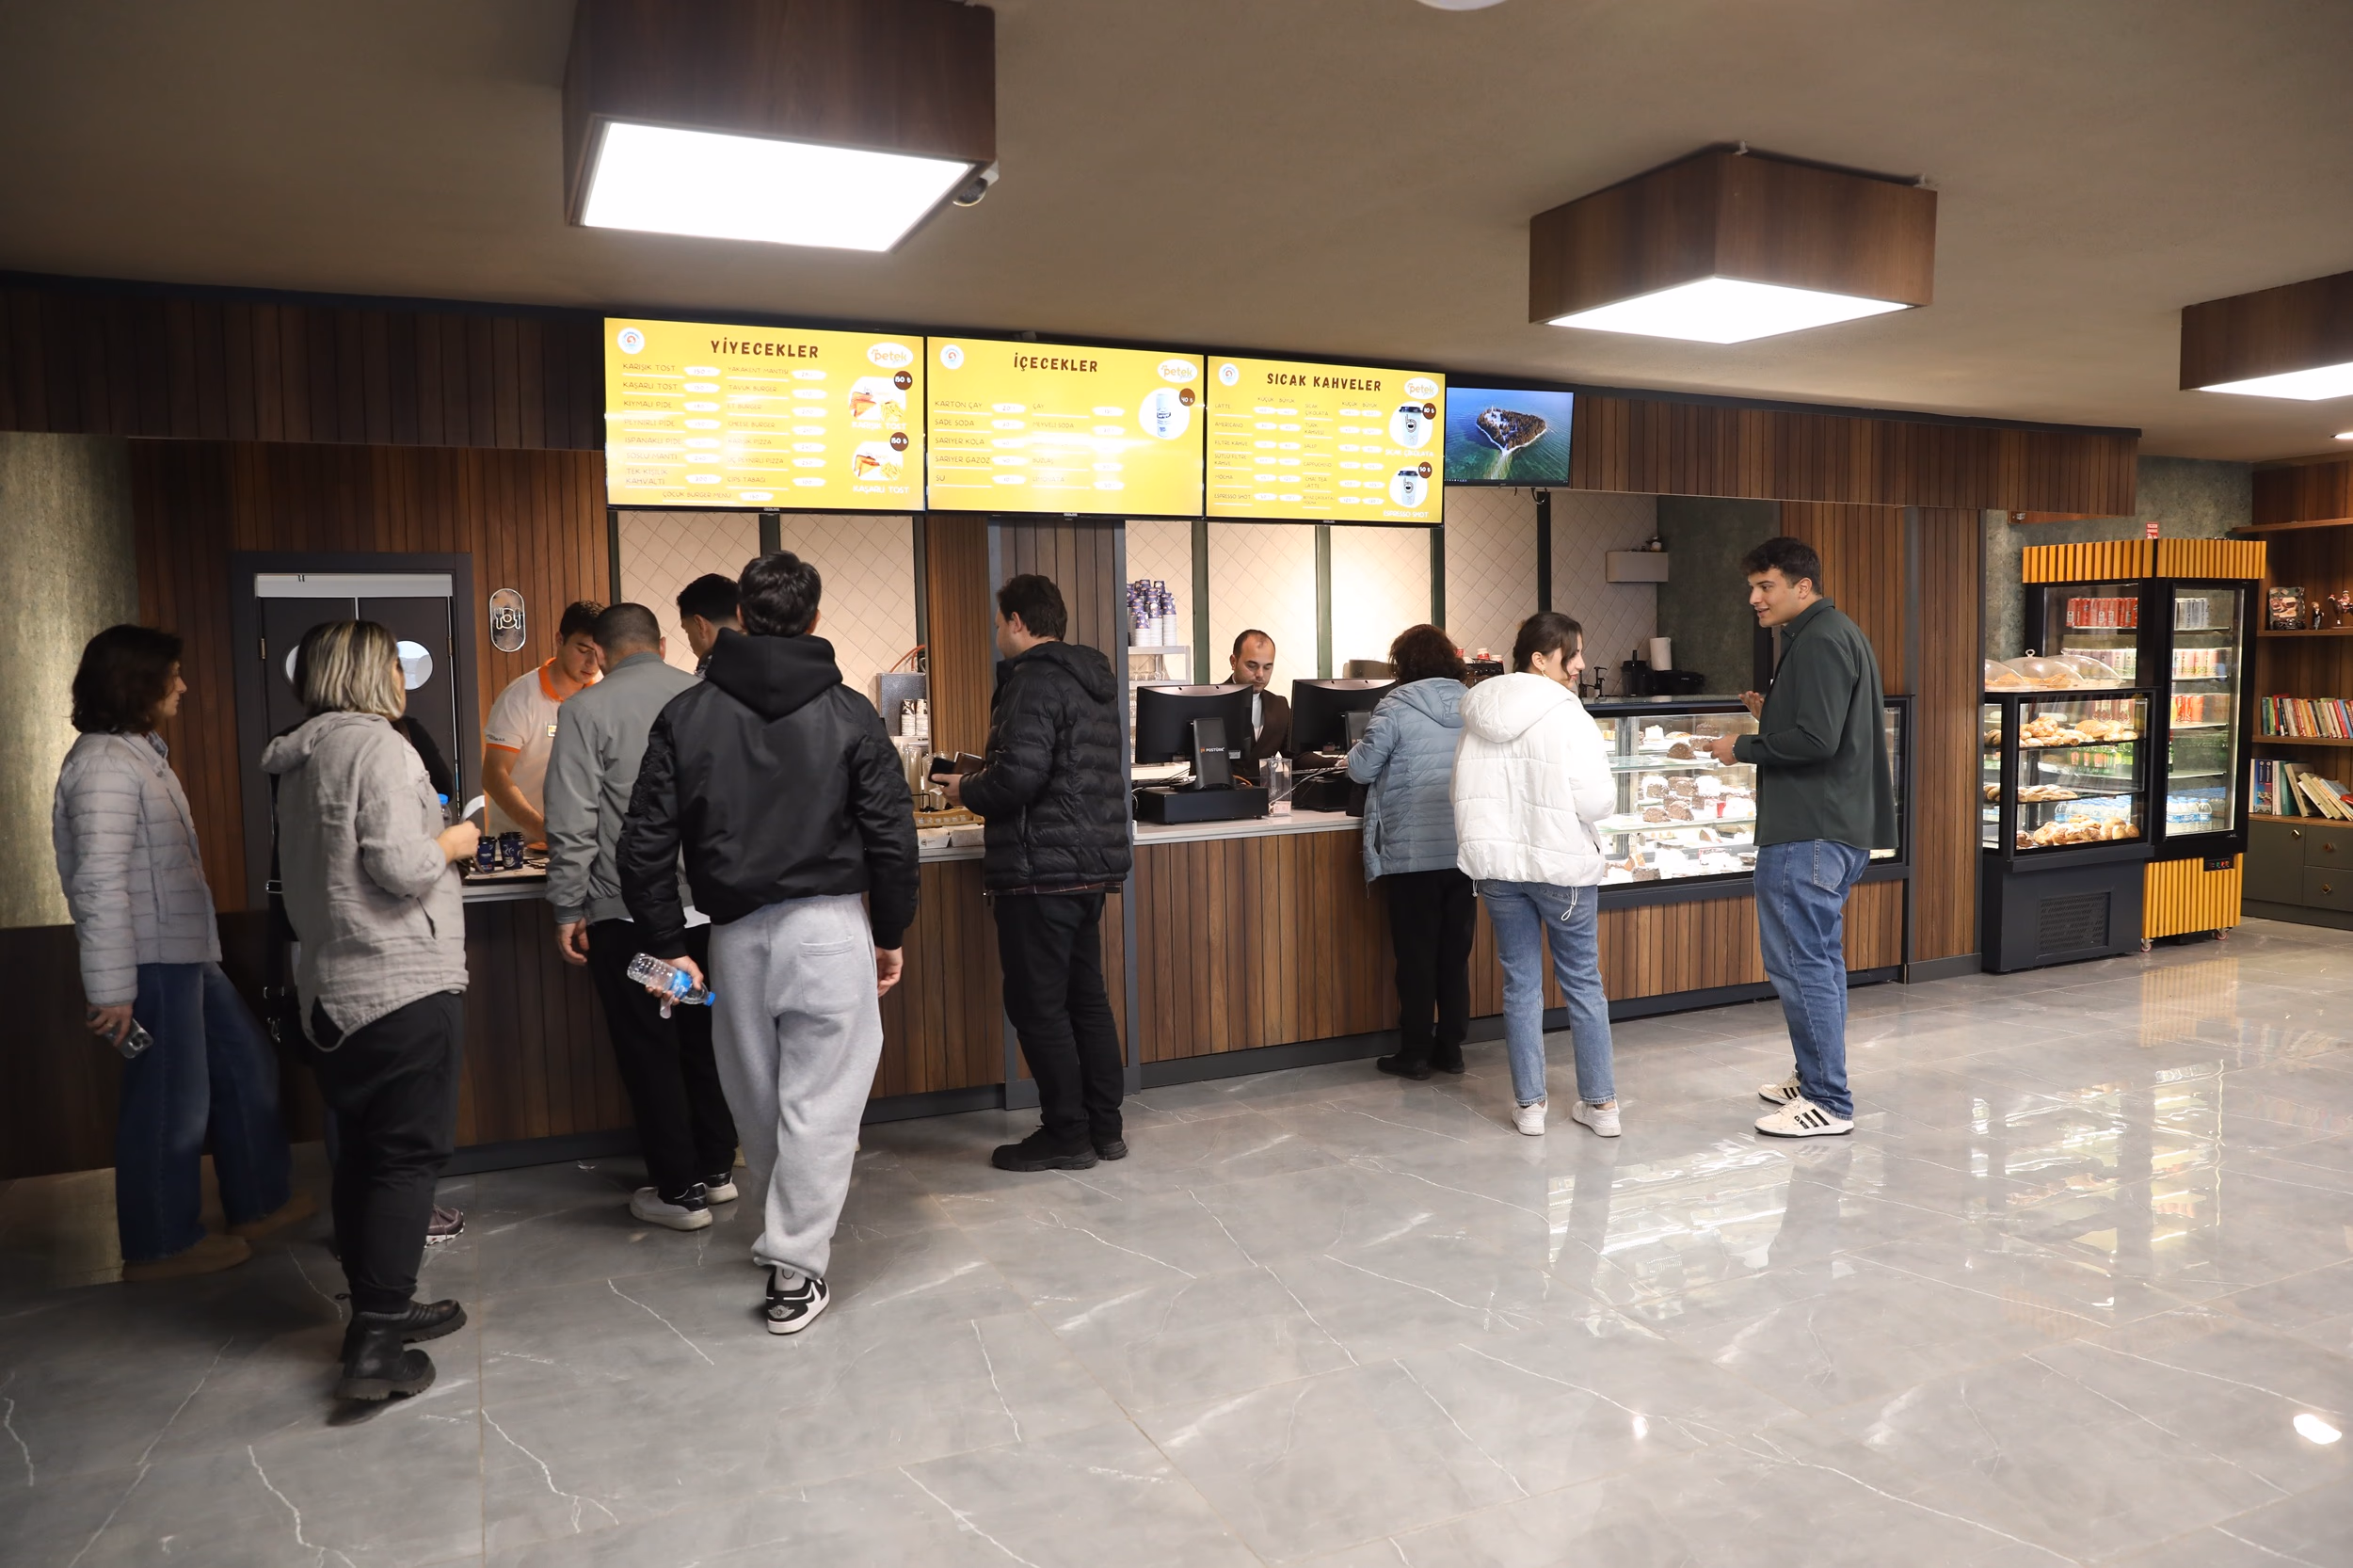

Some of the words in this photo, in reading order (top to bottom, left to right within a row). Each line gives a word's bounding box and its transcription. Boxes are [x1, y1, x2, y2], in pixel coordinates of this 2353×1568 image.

[711, 336, 818, 358] YİYECEKLER
[874, 351, 907, 362] petek
[623, 363, 652, 371] KARIŞIK
[1014, 352, 1098, 372] İÇECEKLER
[1164, 367, 1193, 377] petek
[1267, 373, 1306, 386] SICAK
[1313, 376, 1381, 392] KAHVELER
[1410, 385, 1434, 394] petek
[853, 485, 885, 494] KAŞARLI
